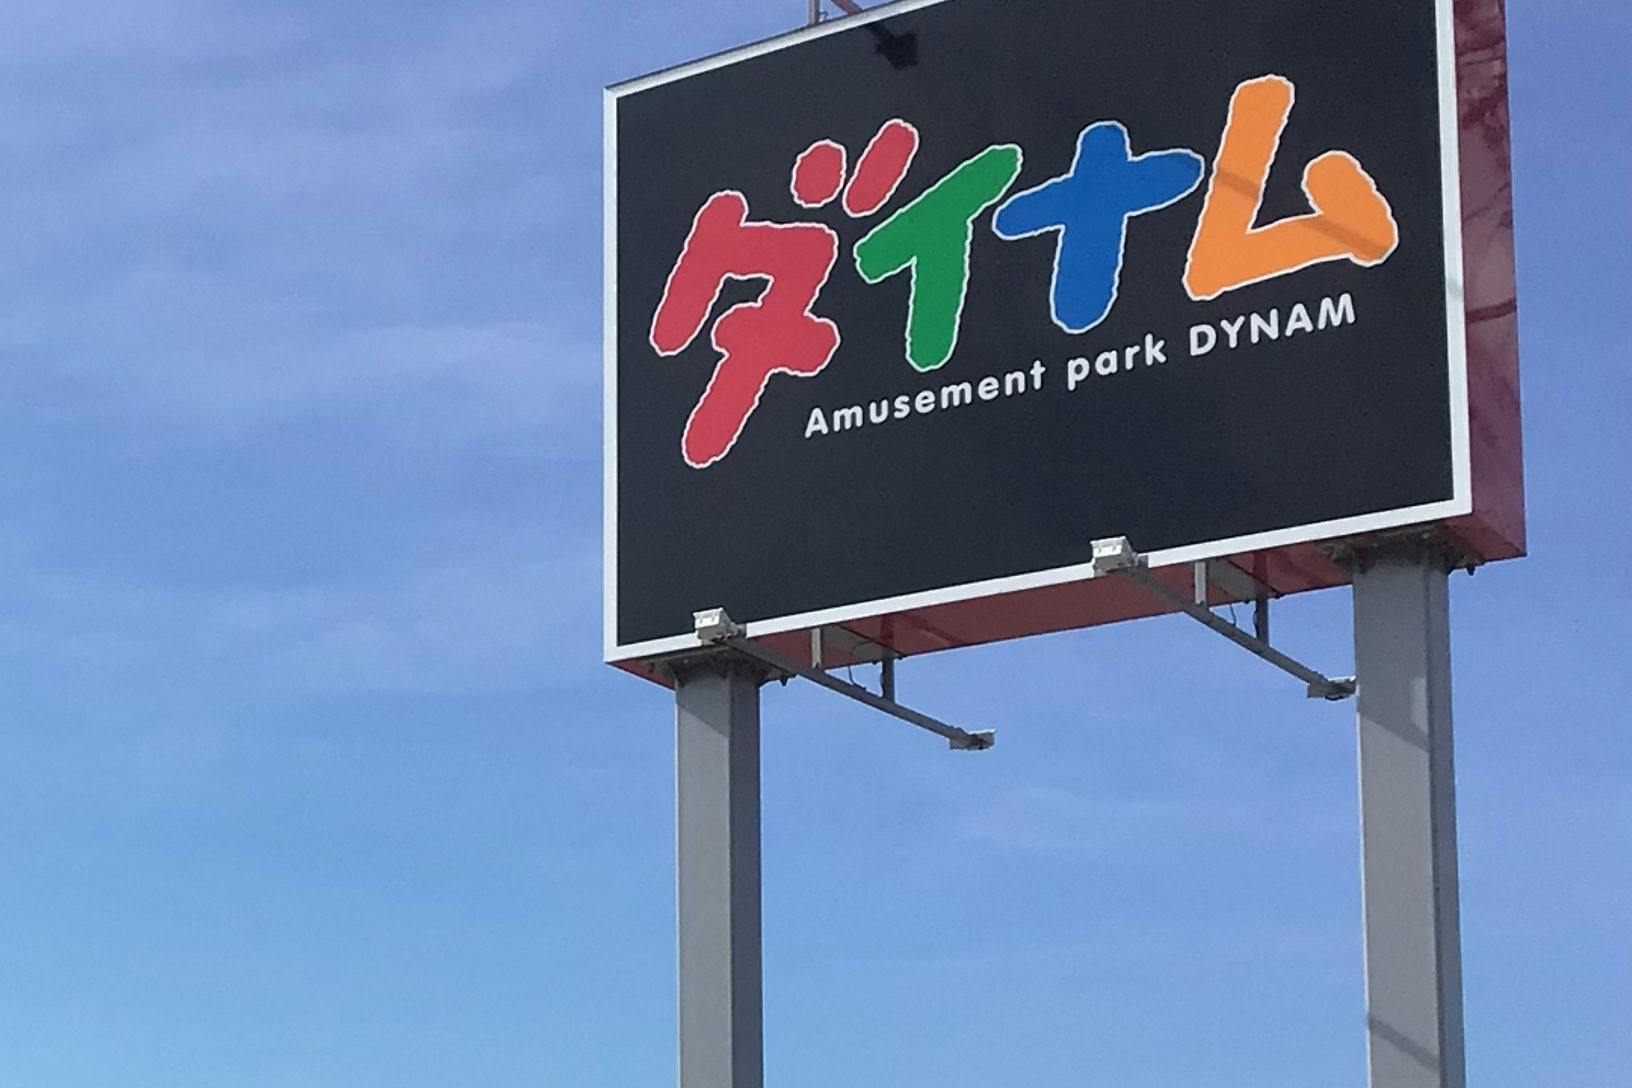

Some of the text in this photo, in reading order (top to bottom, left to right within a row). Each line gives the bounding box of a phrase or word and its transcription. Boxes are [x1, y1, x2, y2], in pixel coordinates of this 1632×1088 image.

[649, 73, 1400, 469] ダイナム
[805, 293, 1355, 438] Amusement park DYNAM
